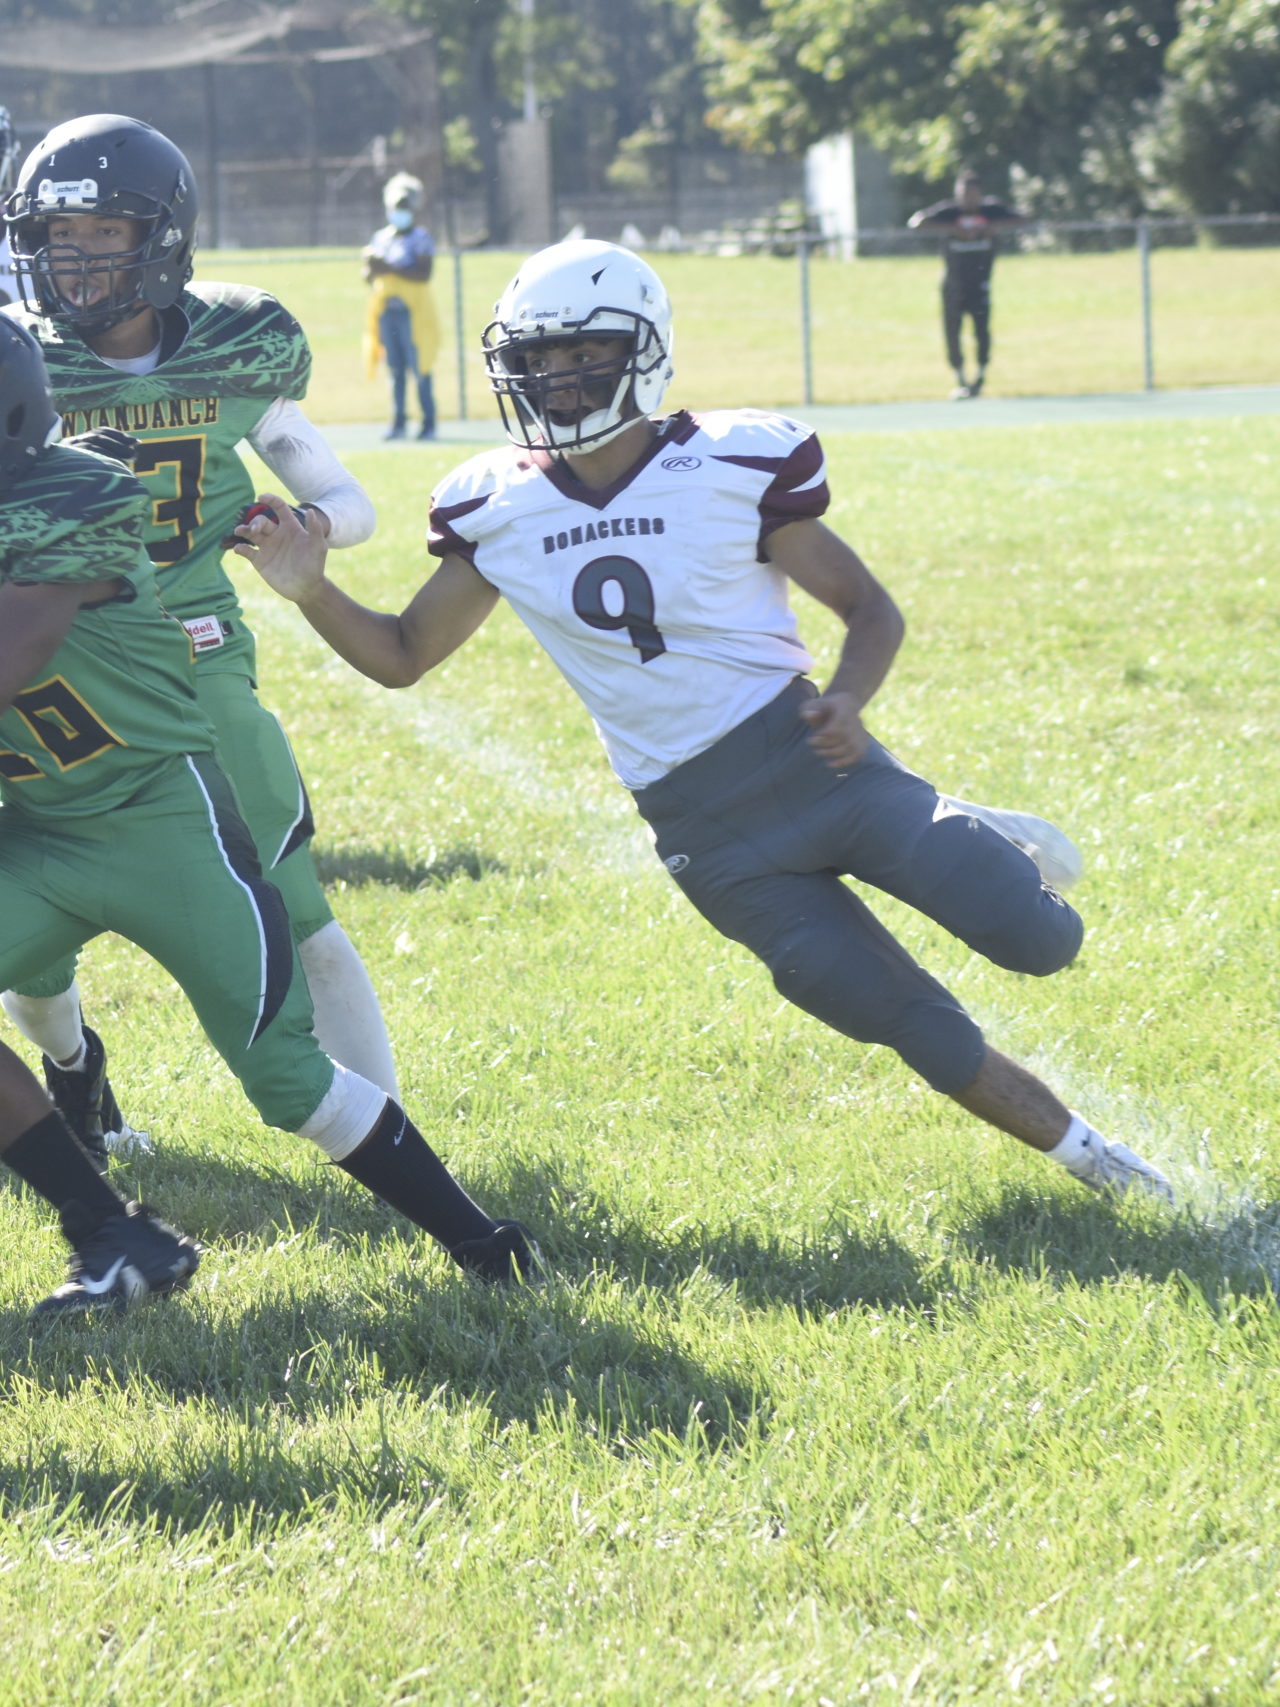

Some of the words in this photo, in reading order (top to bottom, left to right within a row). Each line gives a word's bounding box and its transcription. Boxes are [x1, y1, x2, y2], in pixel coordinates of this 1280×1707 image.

[48, 154, 56, 167] 1
[98, 156, 108, 169] 3
[60, 397, 220, 438] WYANDANCH
[543, 517, 665, 554] BONACKERS
[572, 554, 667, 664] 9
